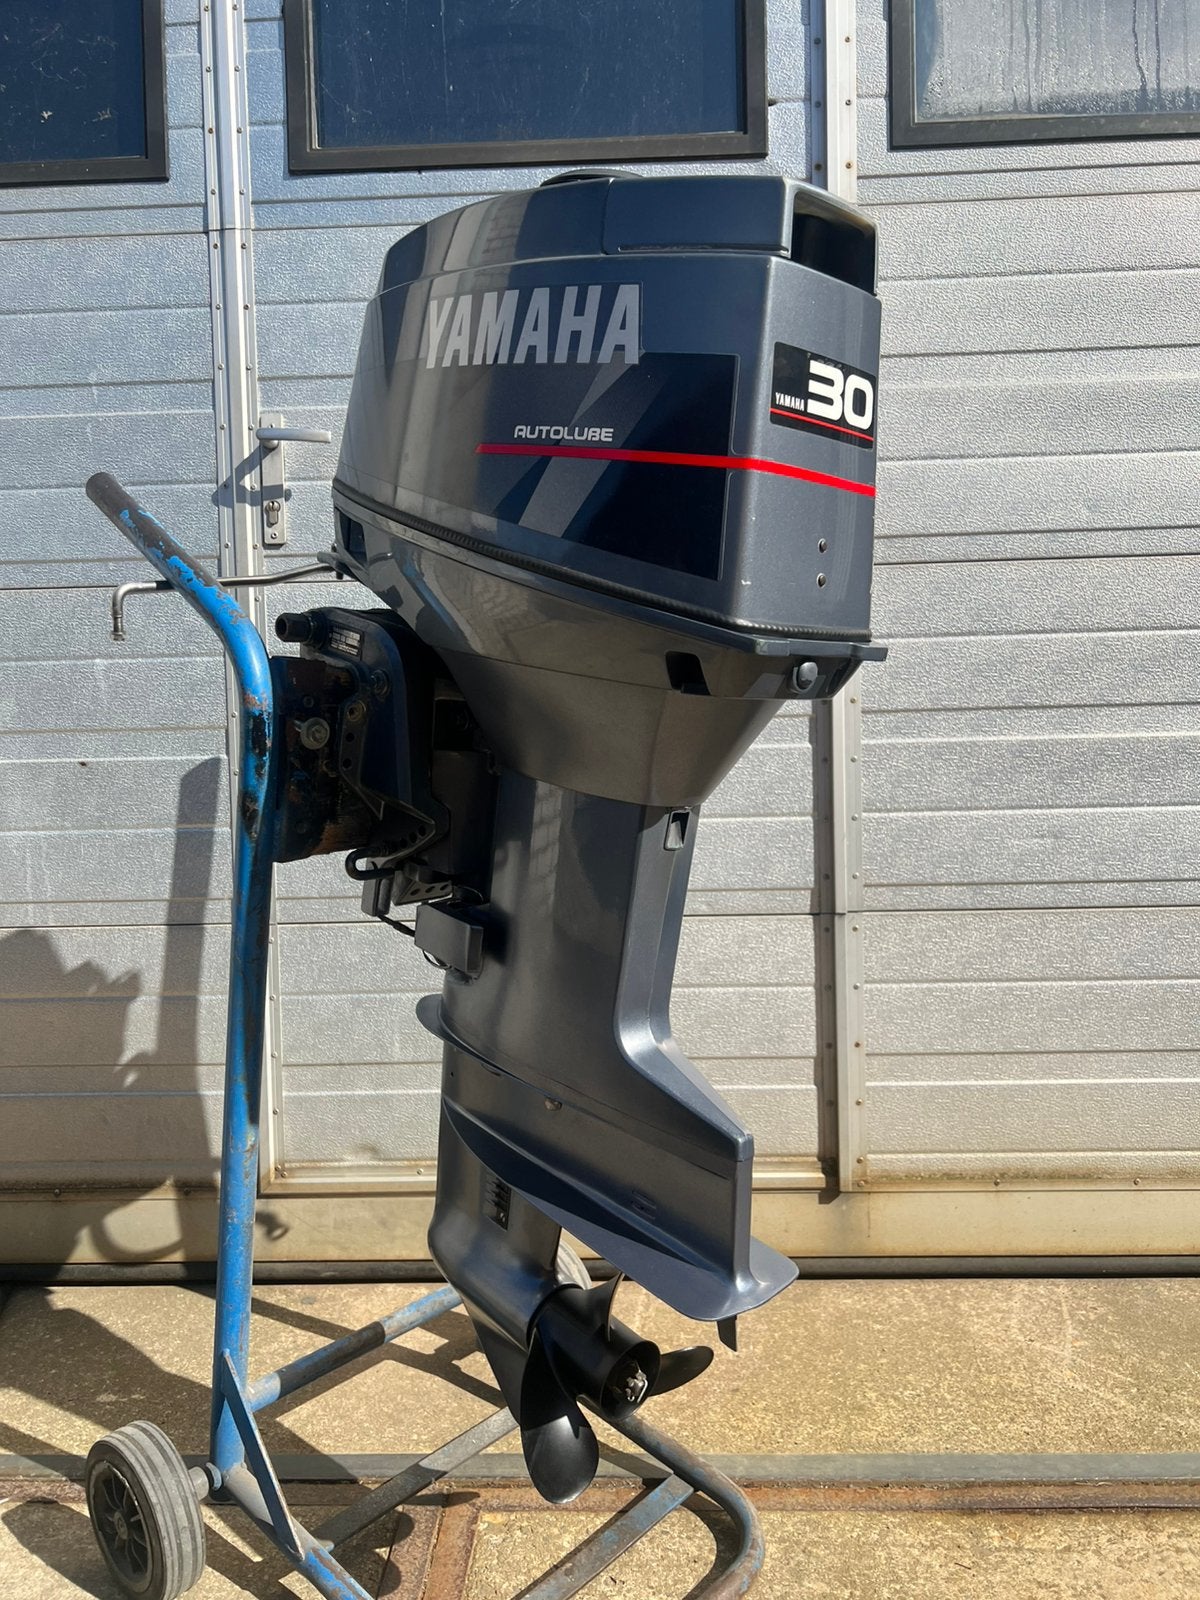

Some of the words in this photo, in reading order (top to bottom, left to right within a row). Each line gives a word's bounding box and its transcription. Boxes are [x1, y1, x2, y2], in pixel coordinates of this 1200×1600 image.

[426, 284, 640, 369] YAMAHA
[775, 392, 805, 412] YAMAHA
[806, 359, 874, 430] 30
[514, 425, 614, 442] AUTOLUBE
